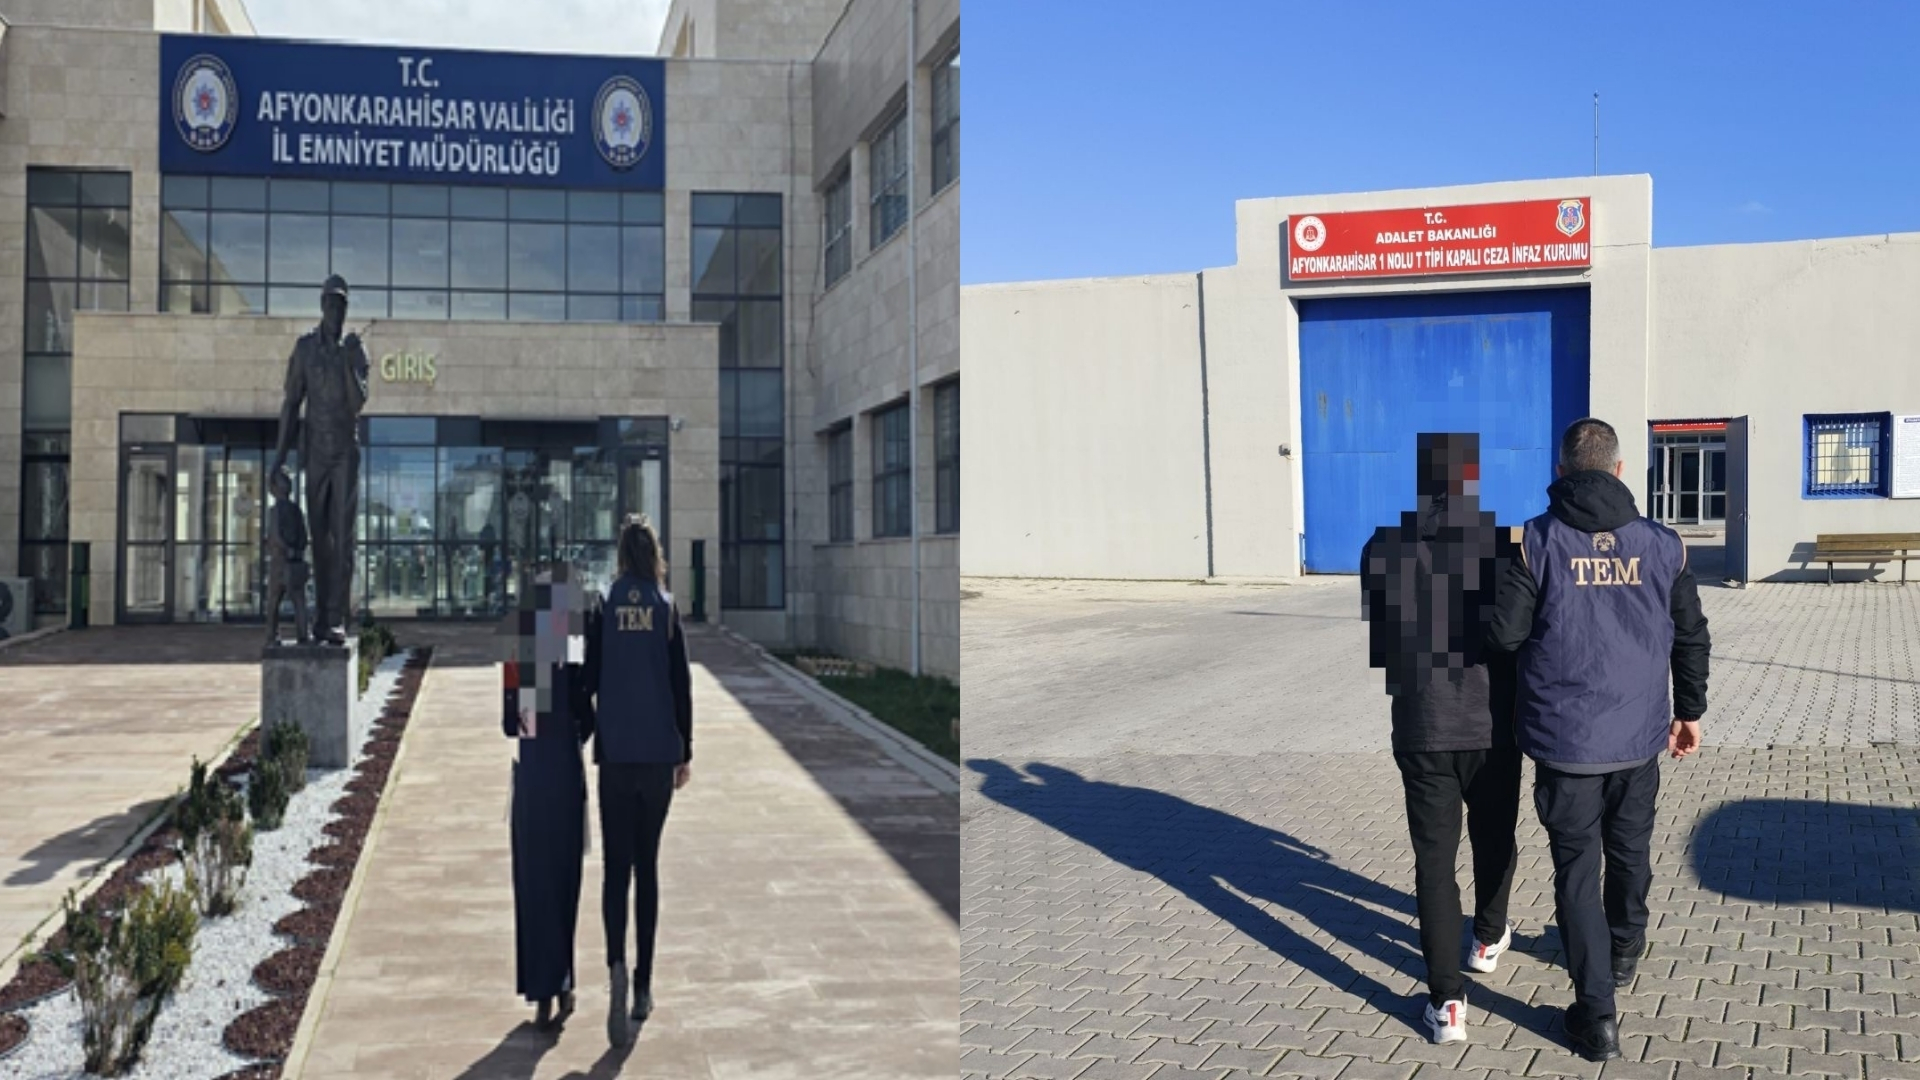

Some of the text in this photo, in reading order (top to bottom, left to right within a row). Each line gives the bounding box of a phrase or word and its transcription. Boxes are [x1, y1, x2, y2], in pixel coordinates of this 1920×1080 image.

[398, 56, 440, 88] T.C.
[257, 91, 475, 131] AFYONKARAHİSAR
[481, 97, 575, 133] VALİLİĞİ
[272, 127, 561, 175] İL EMNİYET MÜDÜRLÜĞÜ
[1376, 224, 1497, 244] ADALET BAKANLIĞI
[1424, 212, 1447, 225] T.C.
[1291, 242, 1589, 274] AFYONKARAHİSAR 1 NOLU T TİPİ KAPALI CEZA İNFAZ KURUMU
[381, 348, 436, 387] GİRİŞ
[1570, 557, 1642, 586] TEM
[614, 605, 654, 631] TEM
